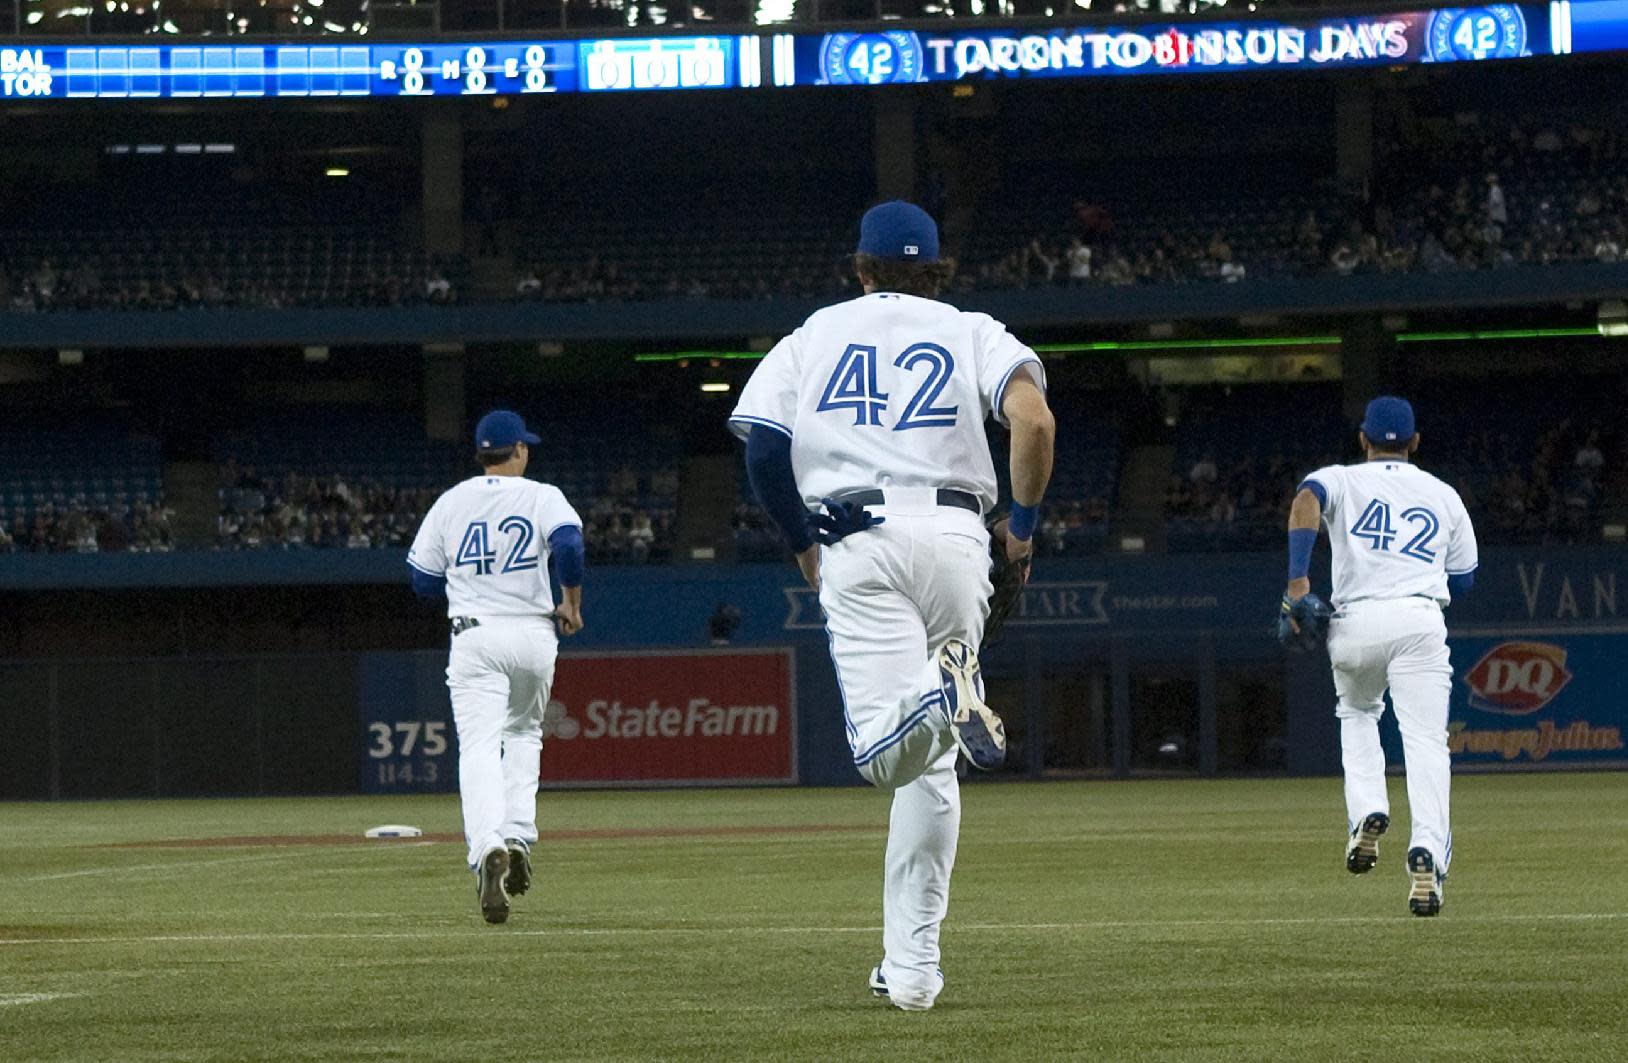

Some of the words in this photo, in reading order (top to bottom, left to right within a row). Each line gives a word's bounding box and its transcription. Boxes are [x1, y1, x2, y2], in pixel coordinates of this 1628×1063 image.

[1454, 16, 1496, 50] 42
[0, 49, 51, 72] BAL
[380, 60, 396, 80] R
[504, 58, 519, 78] E
[849, 42, 893, 76] 42
[0, 73, 52, 96] TOR
[815, 341, 959, 432] 42
[455, 515, 539, 576] 42
[1350, 498, 1440, 565] 42
[1517, 561, 1617, 620] VAN
[1483, 658, 1555, 699] DQ
[368, 721, 448, 759] 375
